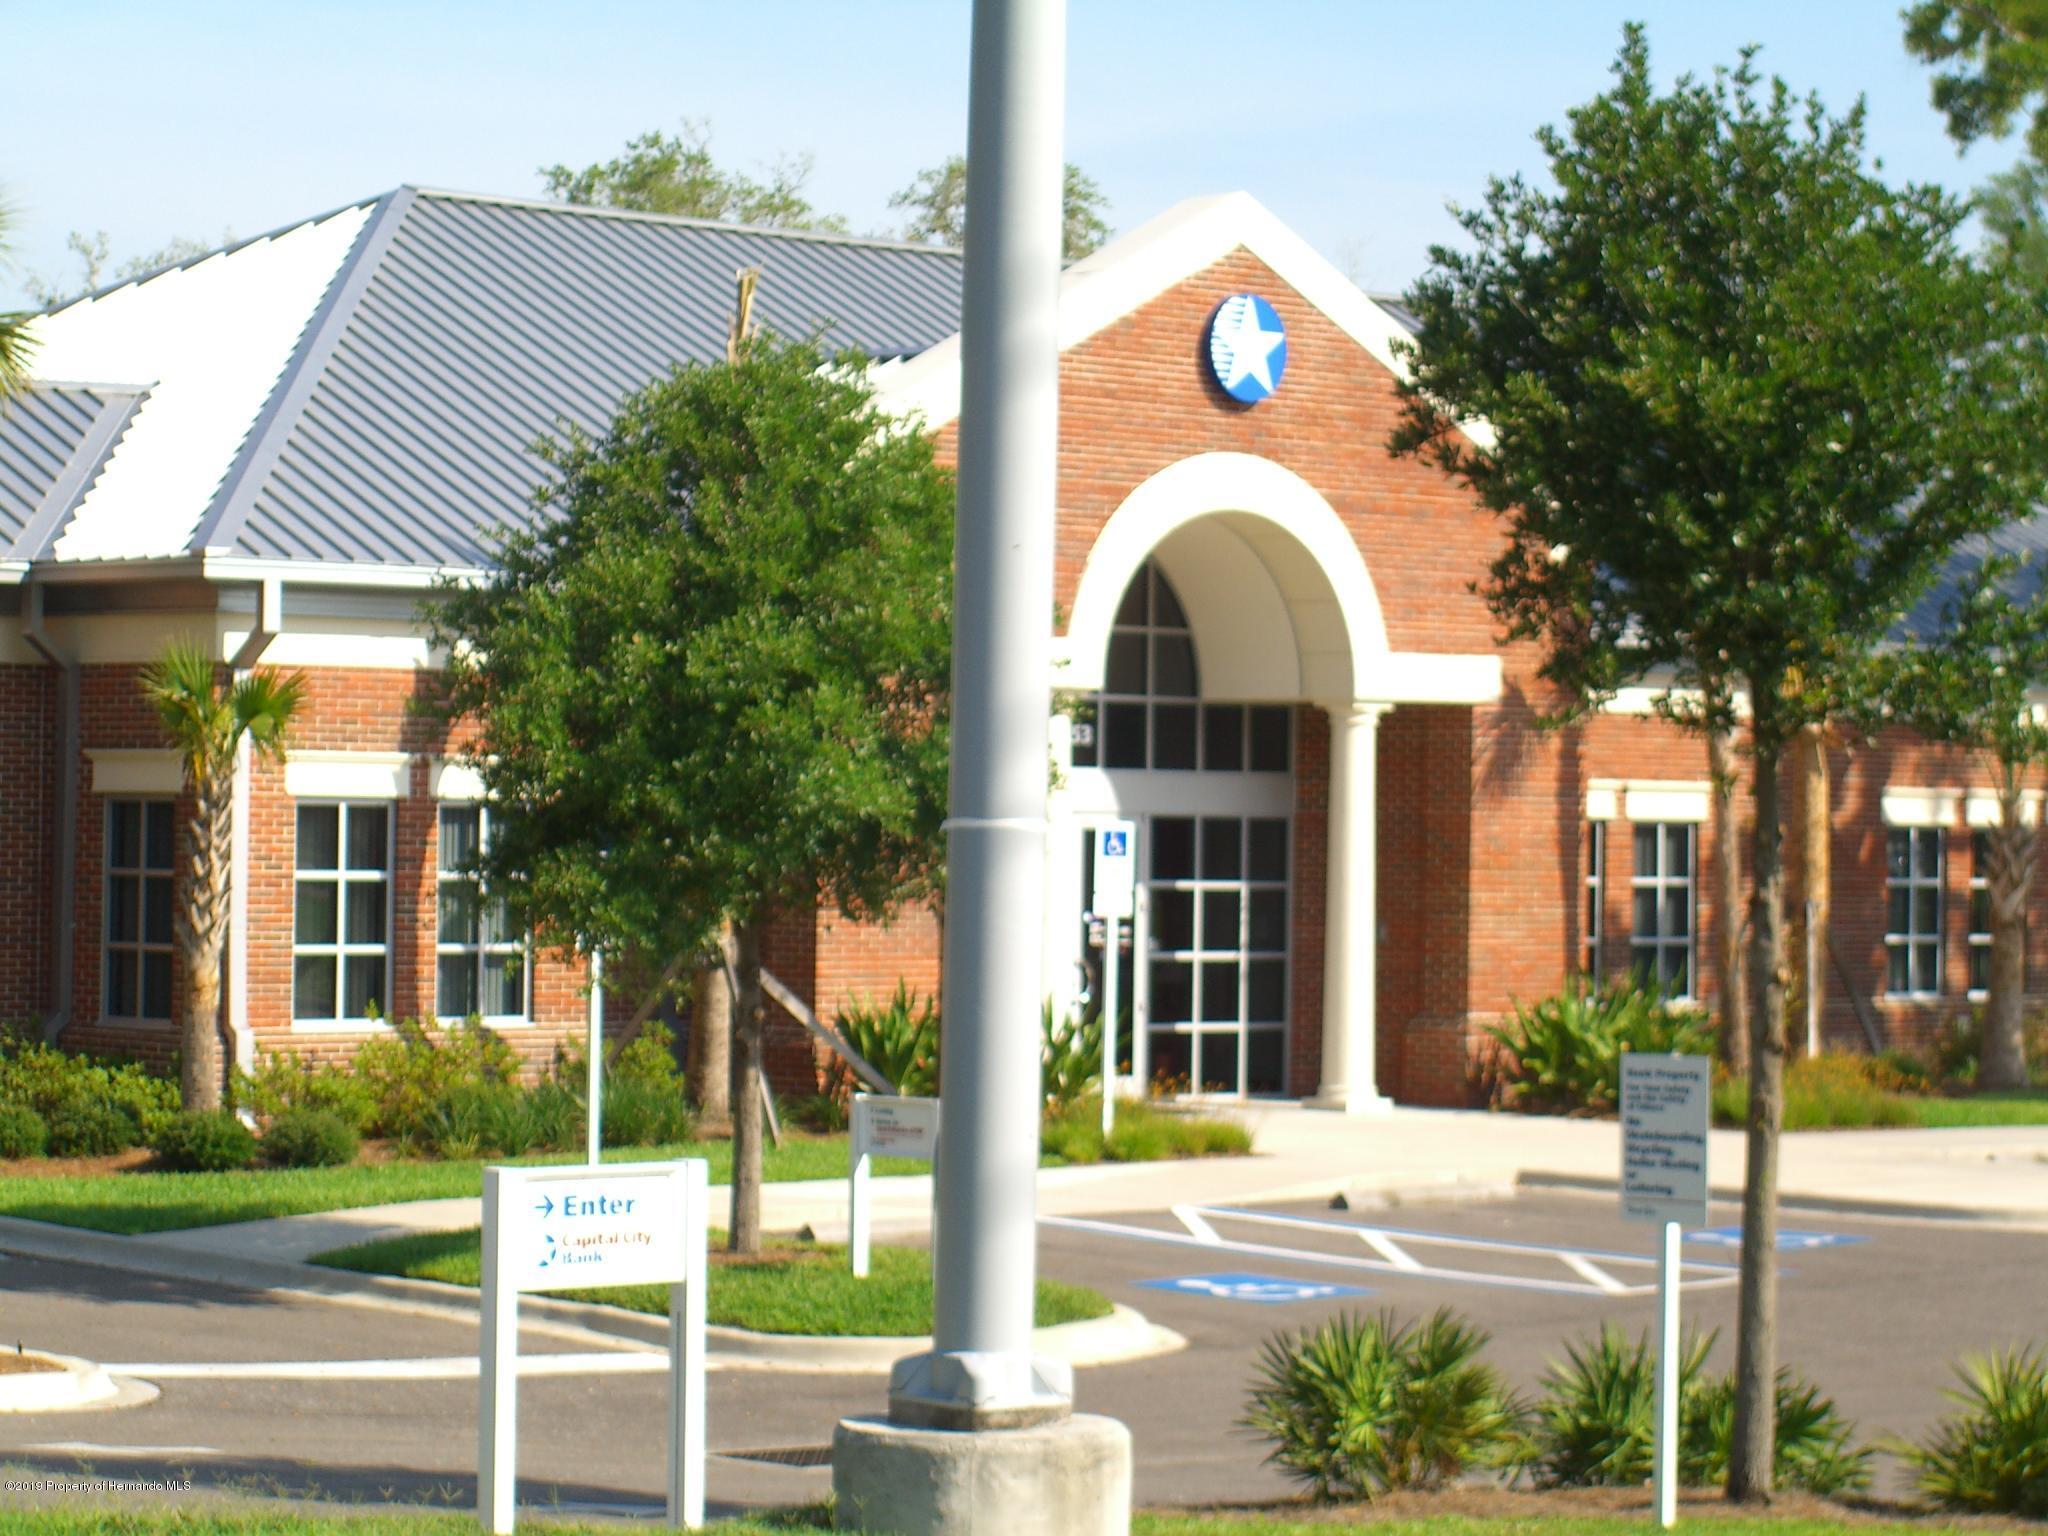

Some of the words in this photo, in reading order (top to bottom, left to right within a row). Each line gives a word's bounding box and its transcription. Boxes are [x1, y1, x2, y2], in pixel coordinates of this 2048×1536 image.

[563, 1195, 636, 1217] Enter
[562, 1231, 619, 1249] Capital
[624, 1230, 653, 1246] City
